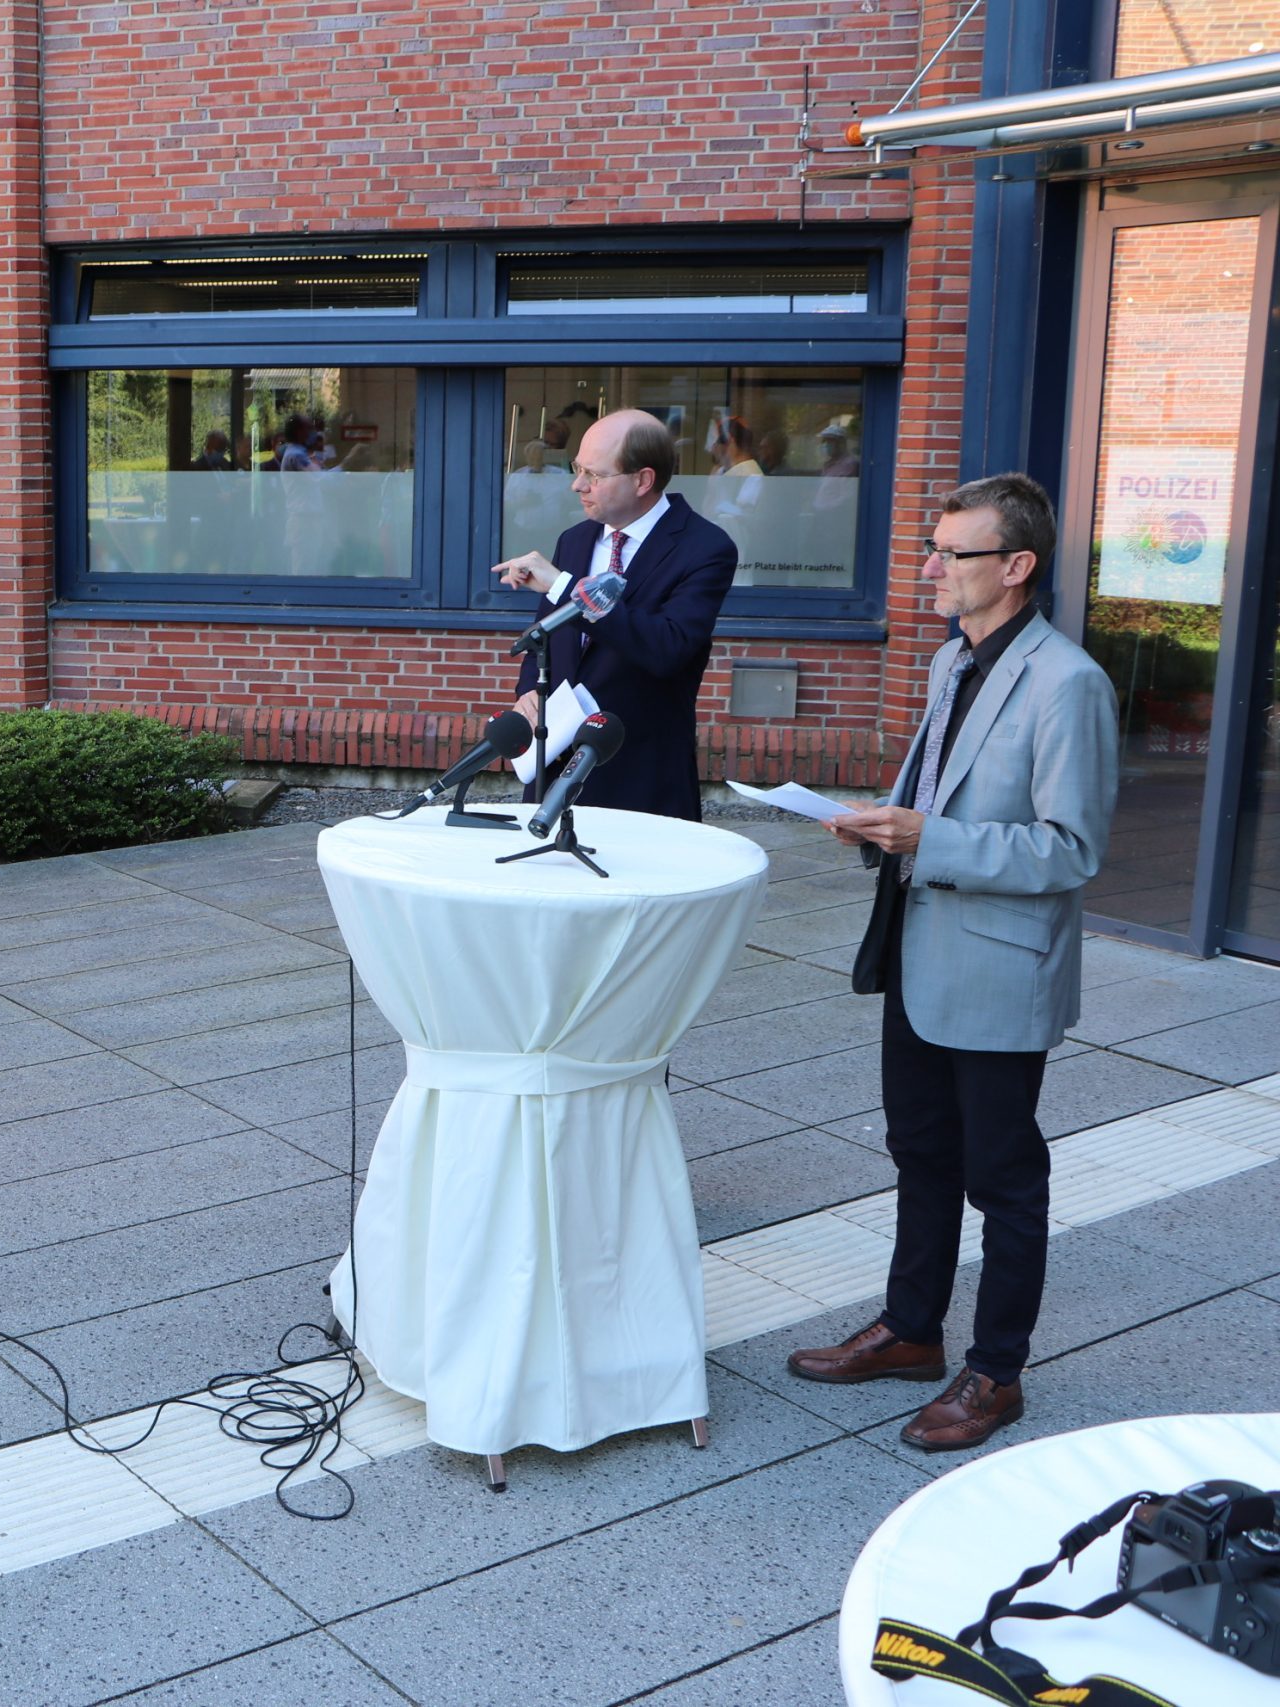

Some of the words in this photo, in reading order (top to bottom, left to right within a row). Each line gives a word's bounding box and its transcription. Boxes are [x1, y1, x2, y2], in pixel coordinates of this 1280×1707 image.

[1118, 475, 1218, 501] POLIZEI
[754, 561, 777, 571] Platz
[778, 562, 802, 571] bleibt
[804, 563, 847, 572] rauchfrei.
[874, 1631, 946, 1667] Nikon
